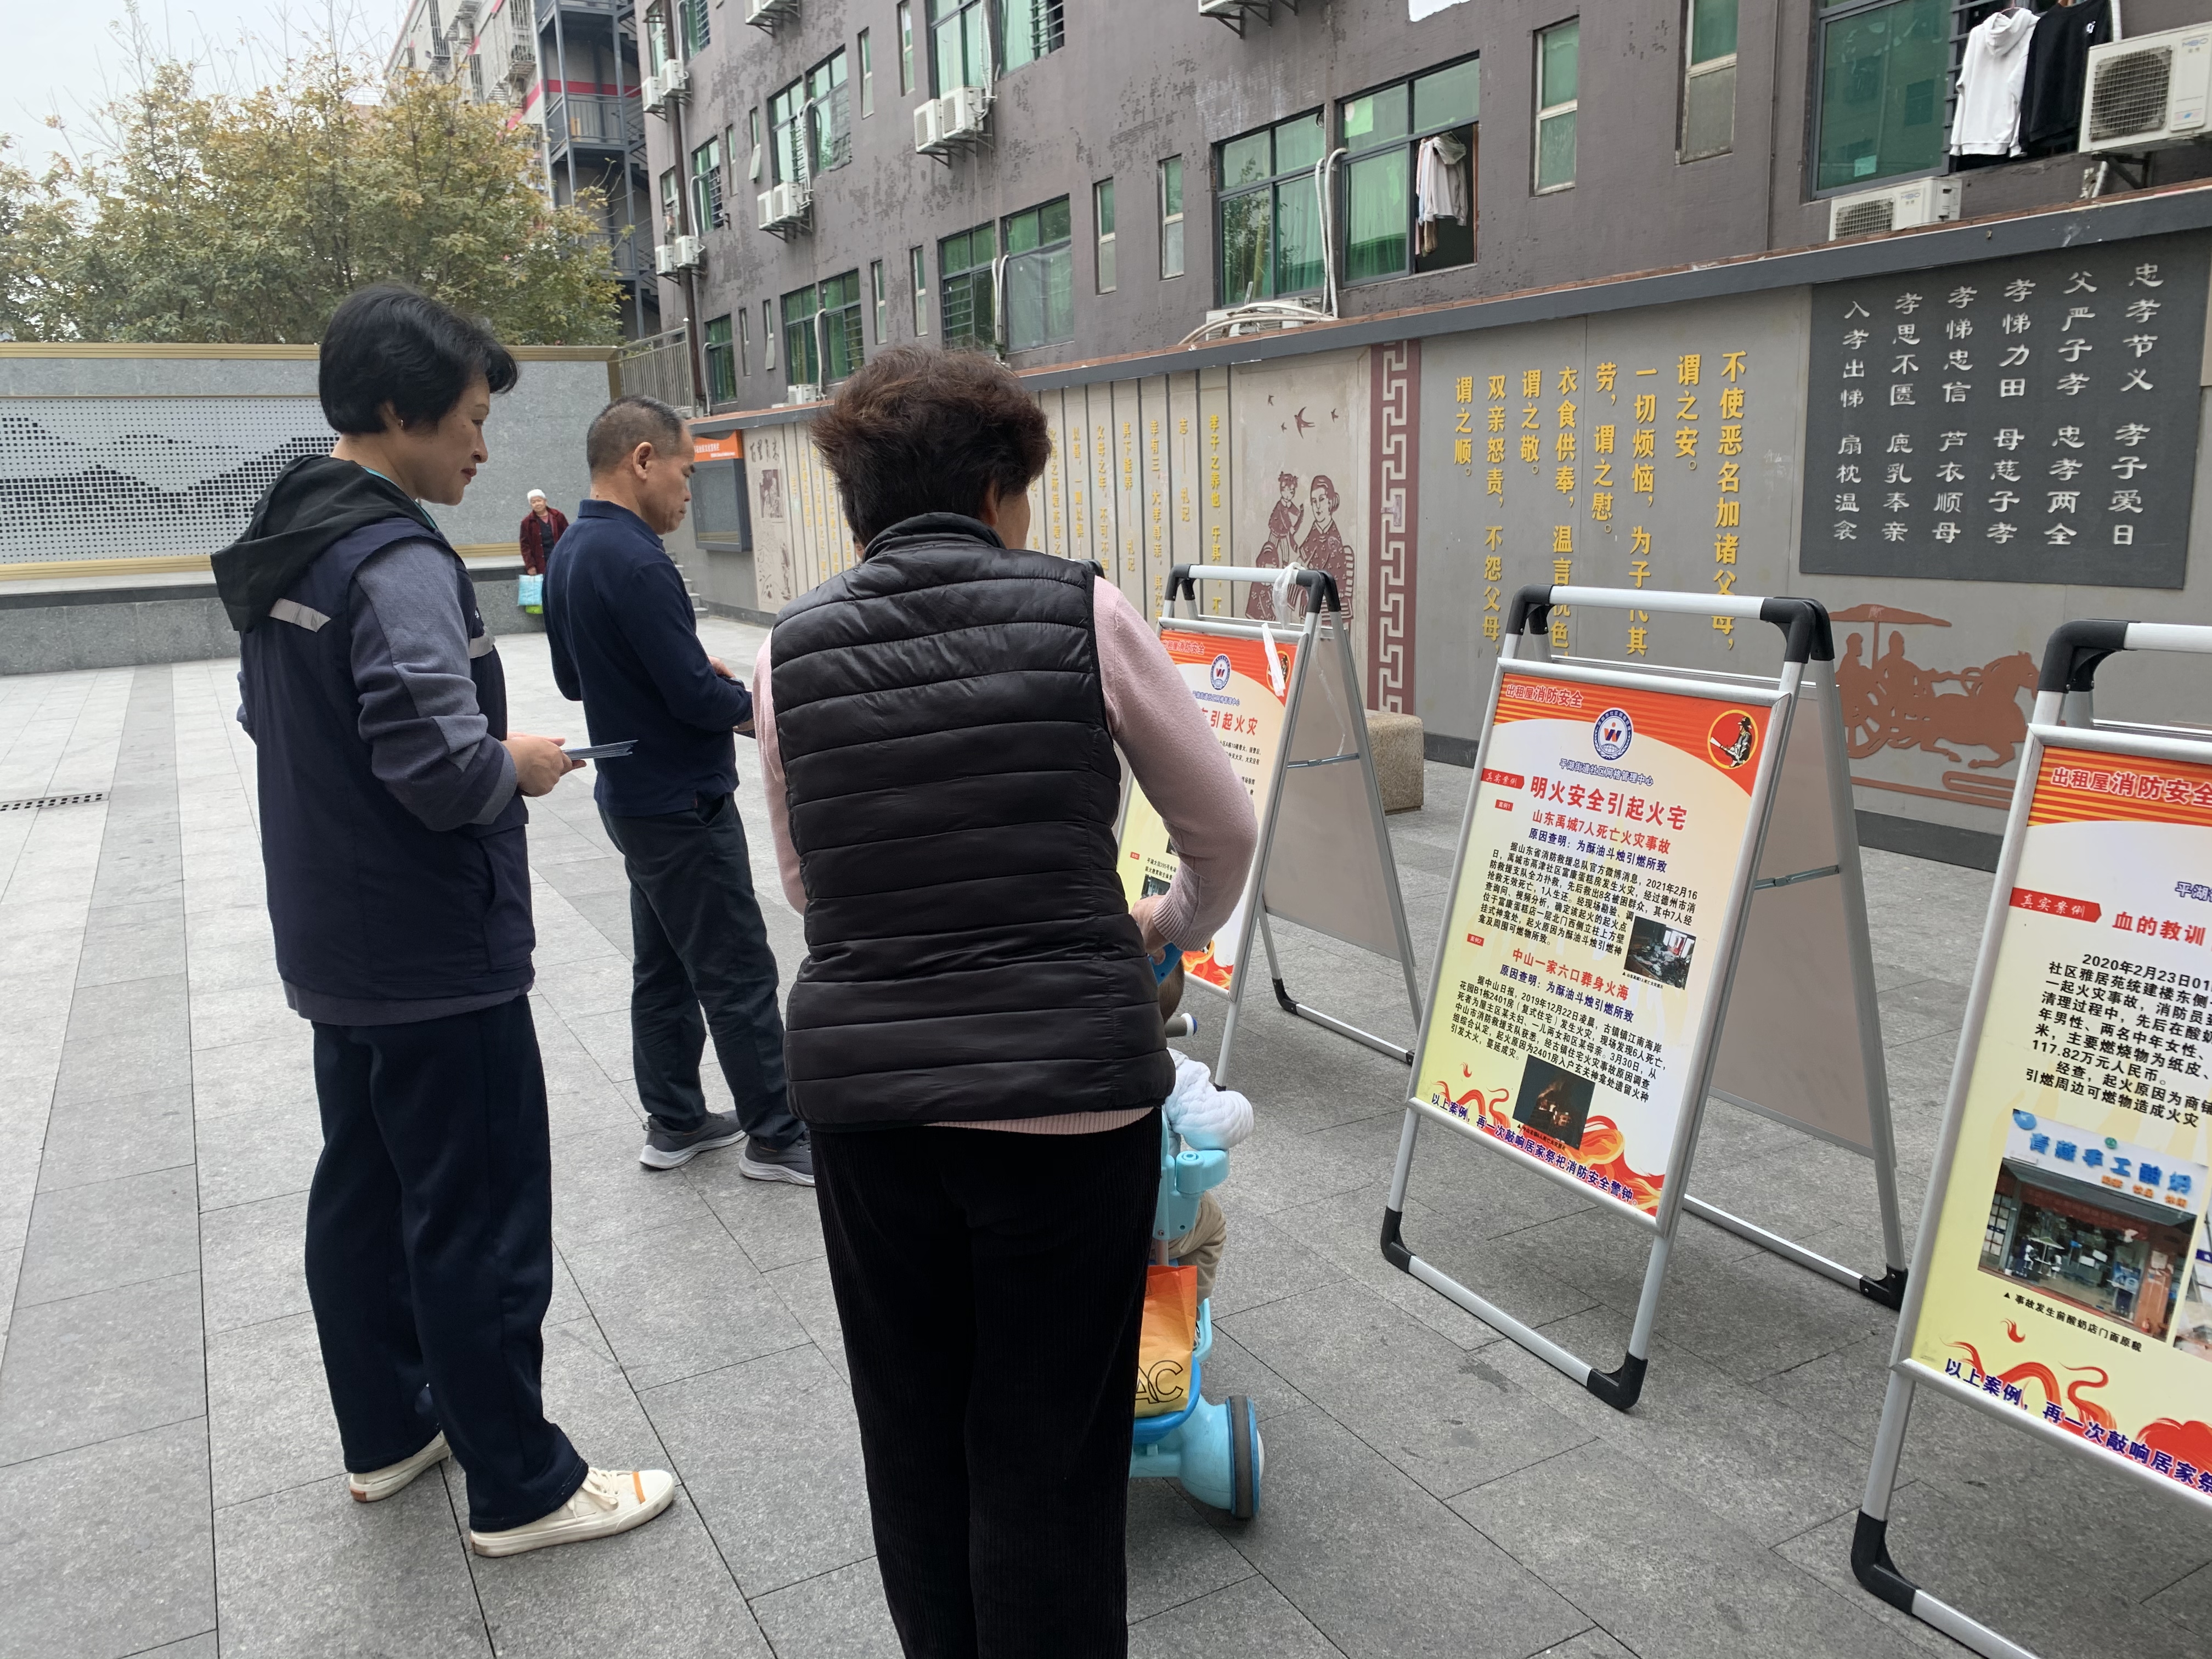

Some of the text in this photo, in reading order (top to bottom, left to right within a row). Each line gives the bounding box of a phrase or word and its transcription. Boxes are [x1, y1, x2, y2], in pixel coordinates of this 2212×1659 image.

[1454, 376, 1473, 476] 谓之顺。
[1520, 369, 1541, 474] 谓之敬。
[1675, 353, 1702, 470] 谓之安。
[1833, 301, 1871, 541] 入孝出悌 扇枕温衾
[1882, 292, 1923, 542] 孝思不匮 鹿乳奉亲
[1932, 286, 1977, 544] 孝悌忠信 芦衣顺母
[1987, 278, 2036, 544] 孝悌力田 母慈子孝
[2044, 270, 2097, 545] 父严子孝 忠孝两全
[2108, 263, 2163, 545] 忠孝节义 孝子爱日
[1592, 361, 1618, 533] 劳，谓之慰。
[1482, 375, 1506, 654] 双亲怒责，不怨父母，
[1505, 685, 1584, 708] 出租屋消防安全
[1486, 771, 1517, 787] 真实案例
[1559, 758, 1654, 787] 平湖街道社区网格管理中心
[2051, 767, 2212, 809] 出租屋消防安全
[1530, 776, 1688, 830] 明火安全引起火宅
[1532, 809, 1671, 855] 山东禹城7人死亡火灾事故
[2021, 894, 2085, 918] 真实案例
[2112, 911, 2212, 951] 血的教训
[1513, 948, 1629, 1001] 中山一家六口葬身火海
[2049, 961, 2212, 1008] 社区雅居苑统建楼东侧
[2083, 954, 2212, 991] 2020年2月23日01
[1451, 1023, 1519, 1060] 引发大火，蔓延成灾。
[2032, 1040, 2166, 1085] 117.82万元人民币。
[2035, 1023, 2209, 1080] 米，主要燃烧物为纸皮、
[2039, 1008, 2204, 1060] 年男性、两名中年女性、
[2026, 1069, 2199, 1128] 引燃周边可燃物造成火灾
[1431, 1093, 1637, 1206] 以上案例，再一次敲响居家祭祀消防安全警钟。
[2014, 1294, 2142, 1353] 事故发生前酸奶店门面原貌
